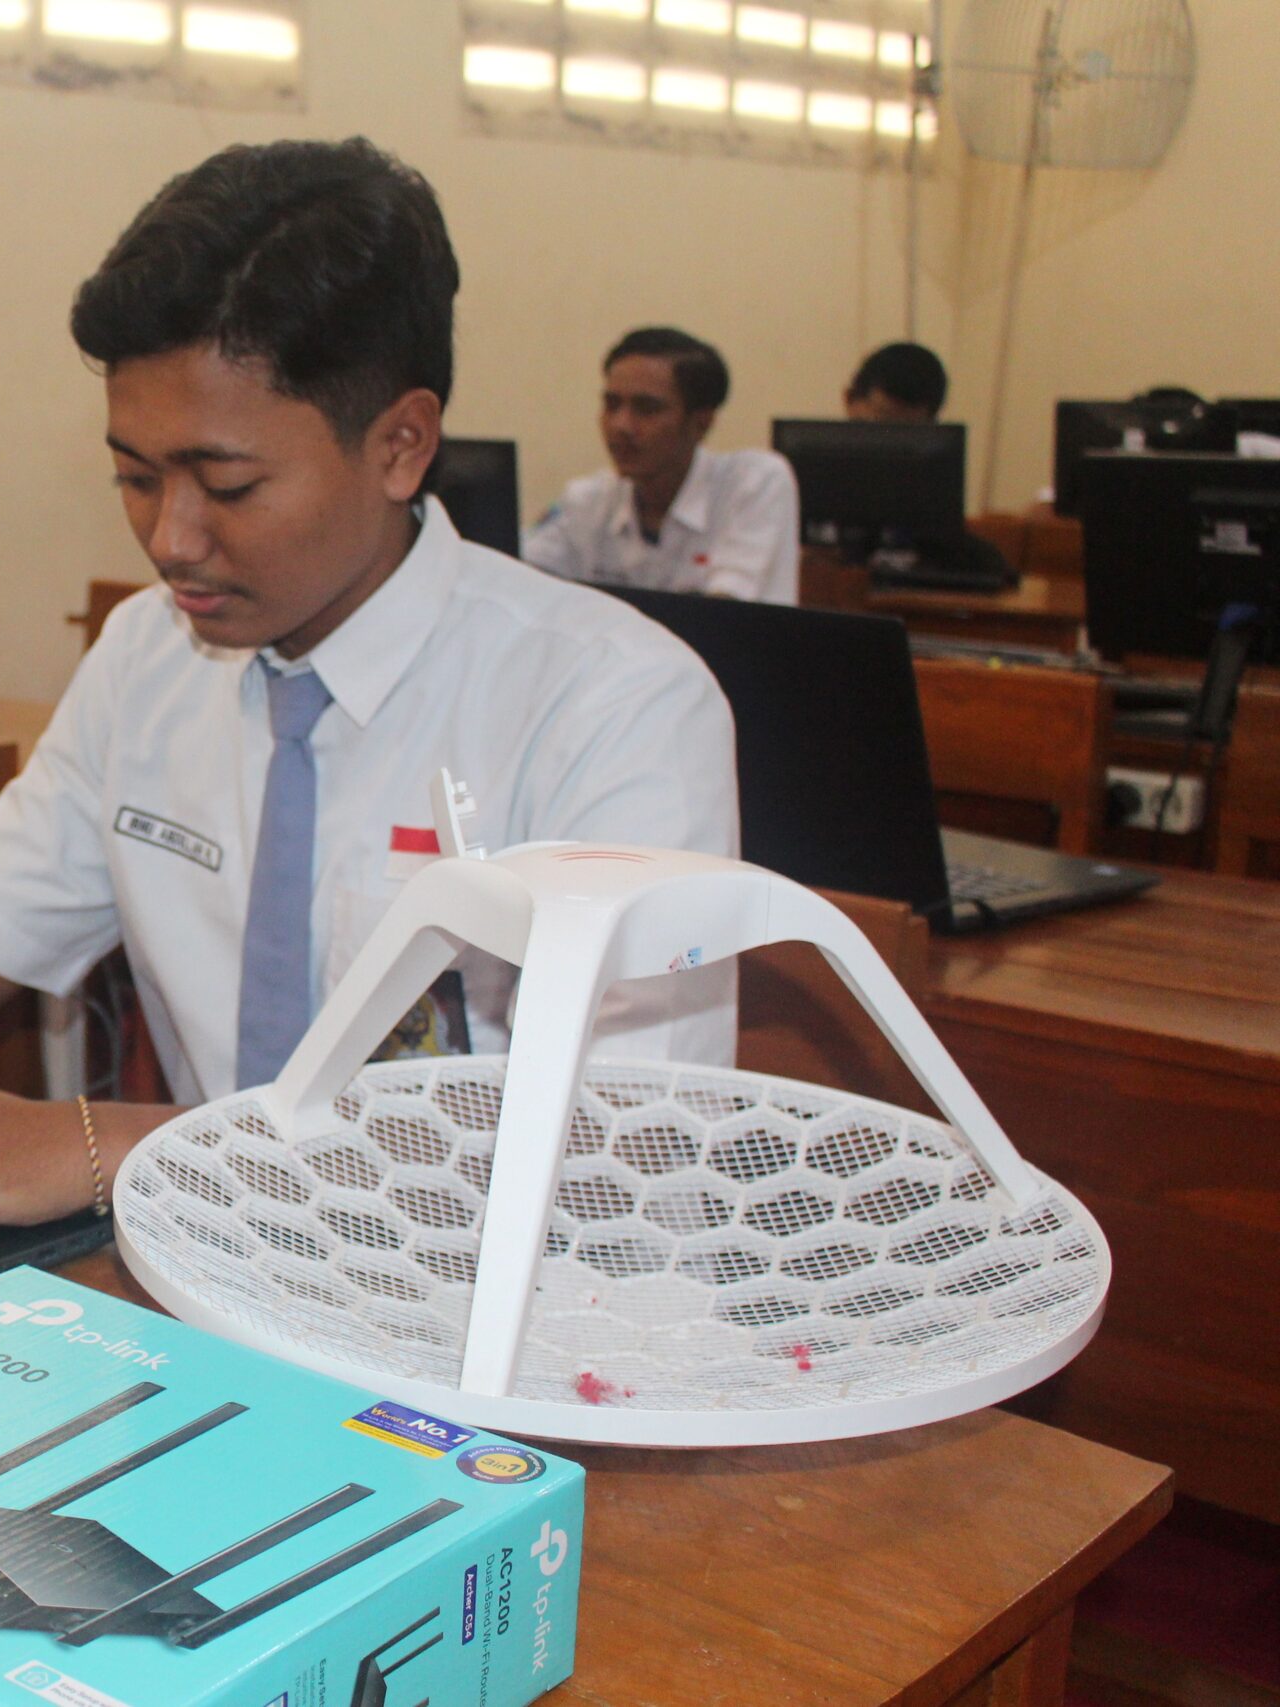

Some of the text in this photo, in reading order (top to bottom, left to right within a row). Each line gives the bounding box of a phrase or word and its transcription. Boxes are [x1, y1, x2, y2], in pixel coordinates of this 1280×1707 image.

[64, 1324, 170, 1371] tp-link
[407, 1418, 448, 1438] No.
[452, 1434, 471, 1443] 1
[465, 1573, 474, 1639] Archer C54
[497, 1547, 513, 1635] AC1200
[531, 1582, 552, 1676] tp-link
[479, 1553, 495, 1707] Dual-Band Wi-Fi Route
